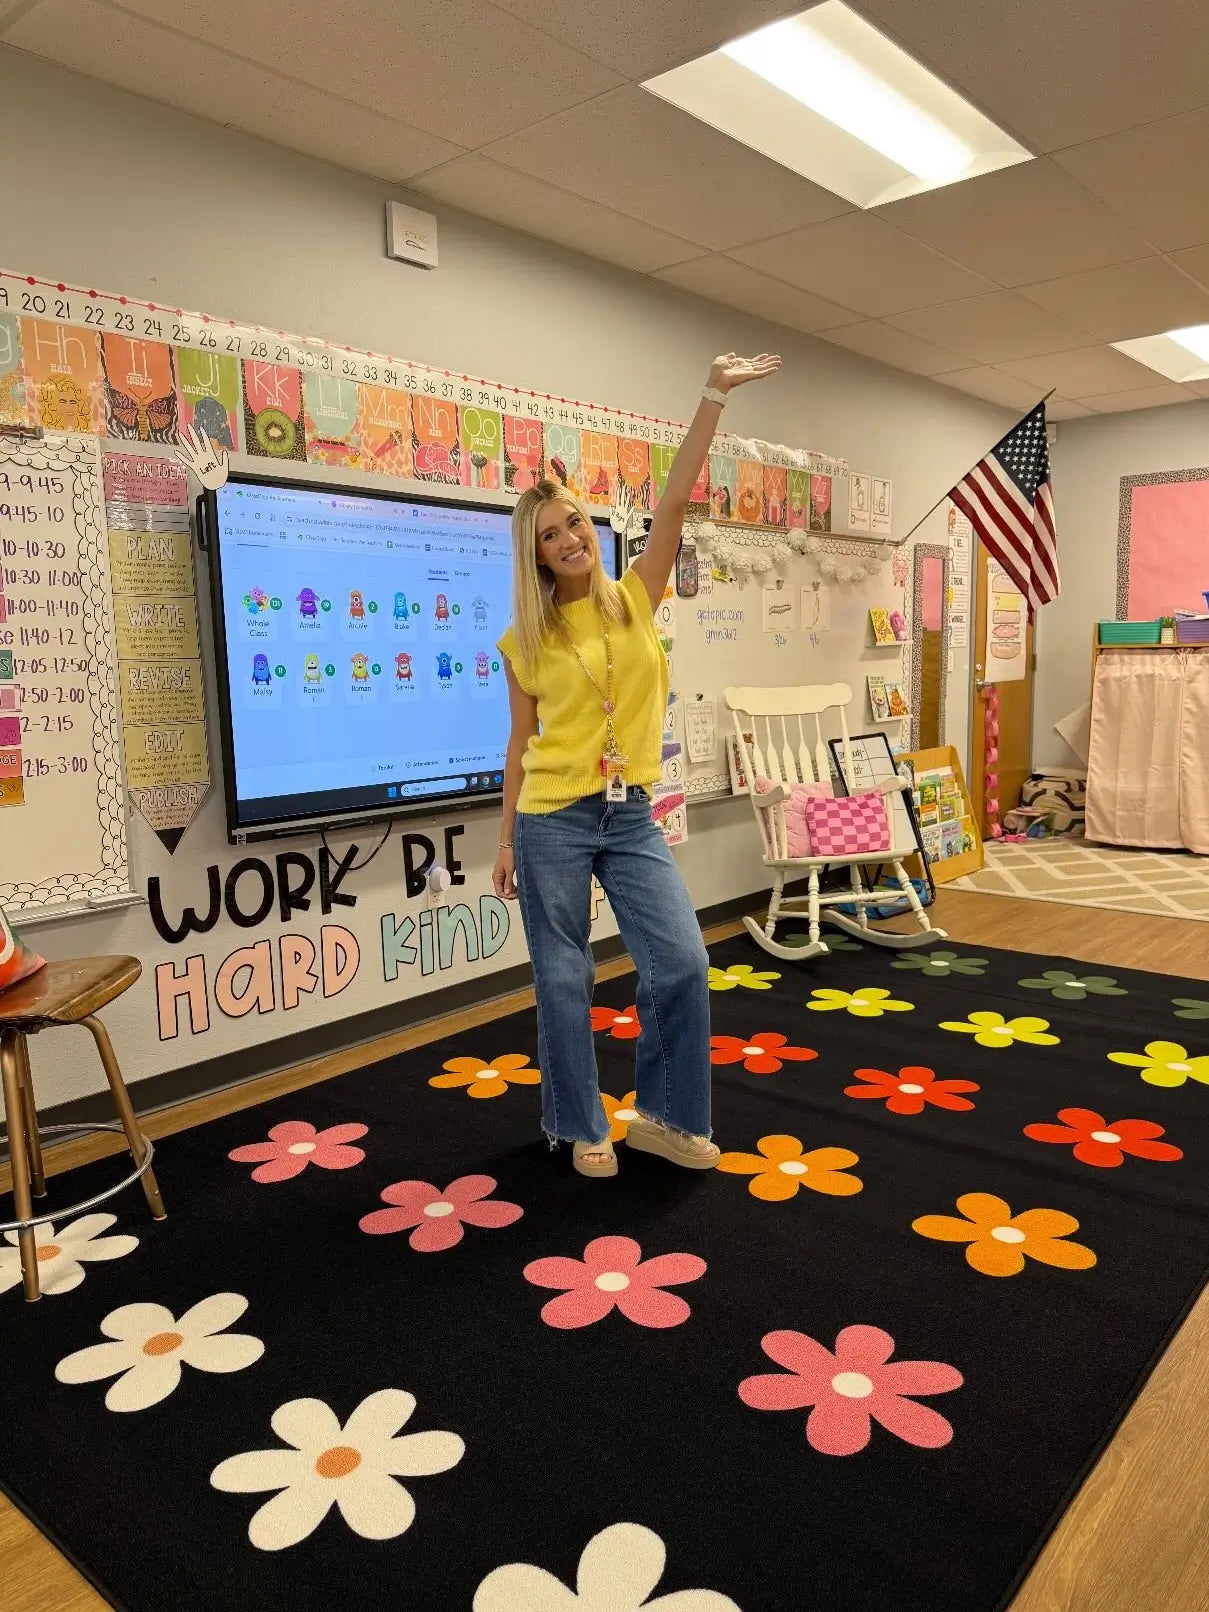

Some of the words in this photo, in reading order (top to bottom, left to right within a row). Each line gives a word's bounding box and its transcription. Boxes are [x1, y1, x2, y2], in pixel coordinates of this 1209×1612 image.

[33, 321, 87, 369] Hh
[21, 292, 46, 313] 20
[54, 300, 71, 319] 21
[84, 305, 106, 326] 22
[114, 312, 135, 331] 23
[143, 318, 163, 337] 24
[172, 324, 191, 342] 25
[199, 329, 217, 347] 26
[225, 335, 241, 353] 27
[250, 340, 268, 357] 28
[275, 345, 290, 362] 29
[297, 350, 315, 366] 30
[321, 355, 333, 371] 31
[342, 359, 358, 377] 32
[363, 364, 378, 381] 33
[383, 369, 398, 386] 34
[404, 374, 418, 390] 35
[422, 378, 436, 394] 36
[441, 382, 454, 397] 37
[459, 387, 473, 402] 38
[478, 391, 490, 406] 39
[493, 394, 507, 410] 40
[512, 399, 521, 413] 41
[527, 402, 539, 417] 42
[543, 405, 555, 420] 43
[558, 408, 569, 421] 44
[572, 411, 584, 425] 45
[587, 414, 598, 428] 46
[601, 417, 611, 431] 47
[614, 420, 625, 433] 48
[628, 423, 638, 435] 49
[640, 425, 650, 438] 50
[653, 428, 661, 441] 51
[664, 430, 674, 443] 52
[721, 442, 730, 454] 57
[732, 443, 741, 456] 58
[781, 454, 789, 466] 63
[841, 467, 848, 478] 70
[195, 353, 220, 396] Jj
[253, 361, 290, 400] Kk
[362, 384, 408, 422] Mm
[418, 397, 451, 432] Nn
[463, 407, 497, 440] Oo
[513, 417, 540, 454] Pp
[622, 439, 644, 468] Ss
[104, 457, 132, 476] PICK
[136, 461, 153, 478] AN
[199, 461, 217, 475] Left
[789, 469, 807, 496] Yy
[126, 535, 174, 561] PLAN
[125, 603, 186, 628] WRITE
[662, 606, 671, 623] 0
[128, 666, 192, 690] REVISE
[668, 711, 674, 727] 2
[143, 729, 185, 754] EDIT
[671, 762, 678, 778] 3
[139, 785, 200, 810] PUBLISH
[675, 813, 681, 828] 4
[401, 824, 466, 899] BE
[147, 843, 360, 944] WORK
